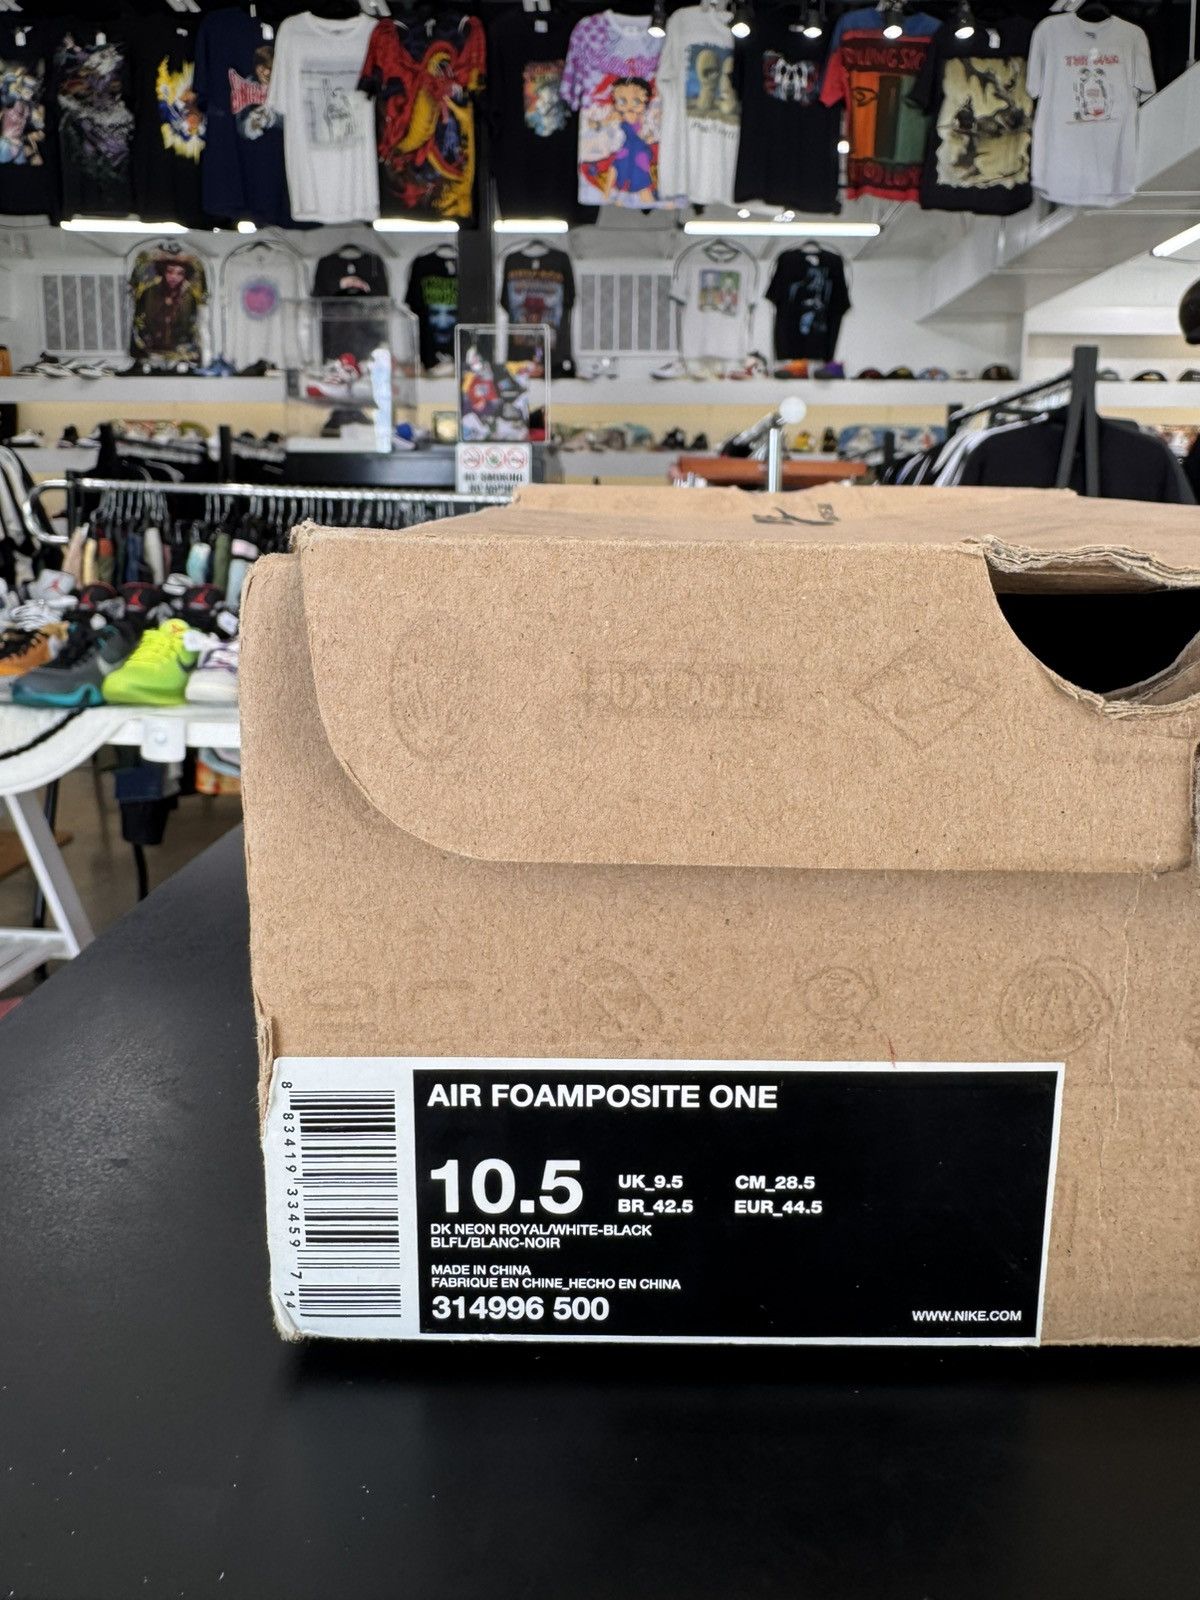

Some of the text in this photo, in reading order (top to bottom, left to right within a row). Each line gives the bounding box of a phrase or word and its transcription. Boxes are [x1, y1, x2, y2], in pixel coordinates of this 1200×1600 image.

[281, 1081, 293, 1089] 8
[427, 1084, 778, 1109] AIR FOAMPOSITE ONE
[282, 1112, 297, 1173] 83419
[430, 1158, 584, 1216] 10.5
[618, 1174, 684, 1192] UK_9.5
[734, 1174, 816, 1193] CM_28.5
[618, 1198, 694, 1217] BR_42.5
[734, 1199, 823, 1218] EUR_44.5
[287, 1188, 301, 1248] 33459
[430, 1224, 653, 1238] DK NEON ROYAL/WHITE-BLACK
[430, 1237, 561, 1250] BLFL/BLANC-NOIR
[290, 1271, 303, 1280] 7
[431, 1264, 532, 1277] MADE IN CHINA
[431, 1277, 682, 1292] FABRIQUE EN CHINE_HECHO EN CHINA
[431, 1296, 610, 1321] 314996 500
[911, 1309, 1022, 1322] WWW.NIKE.COM
